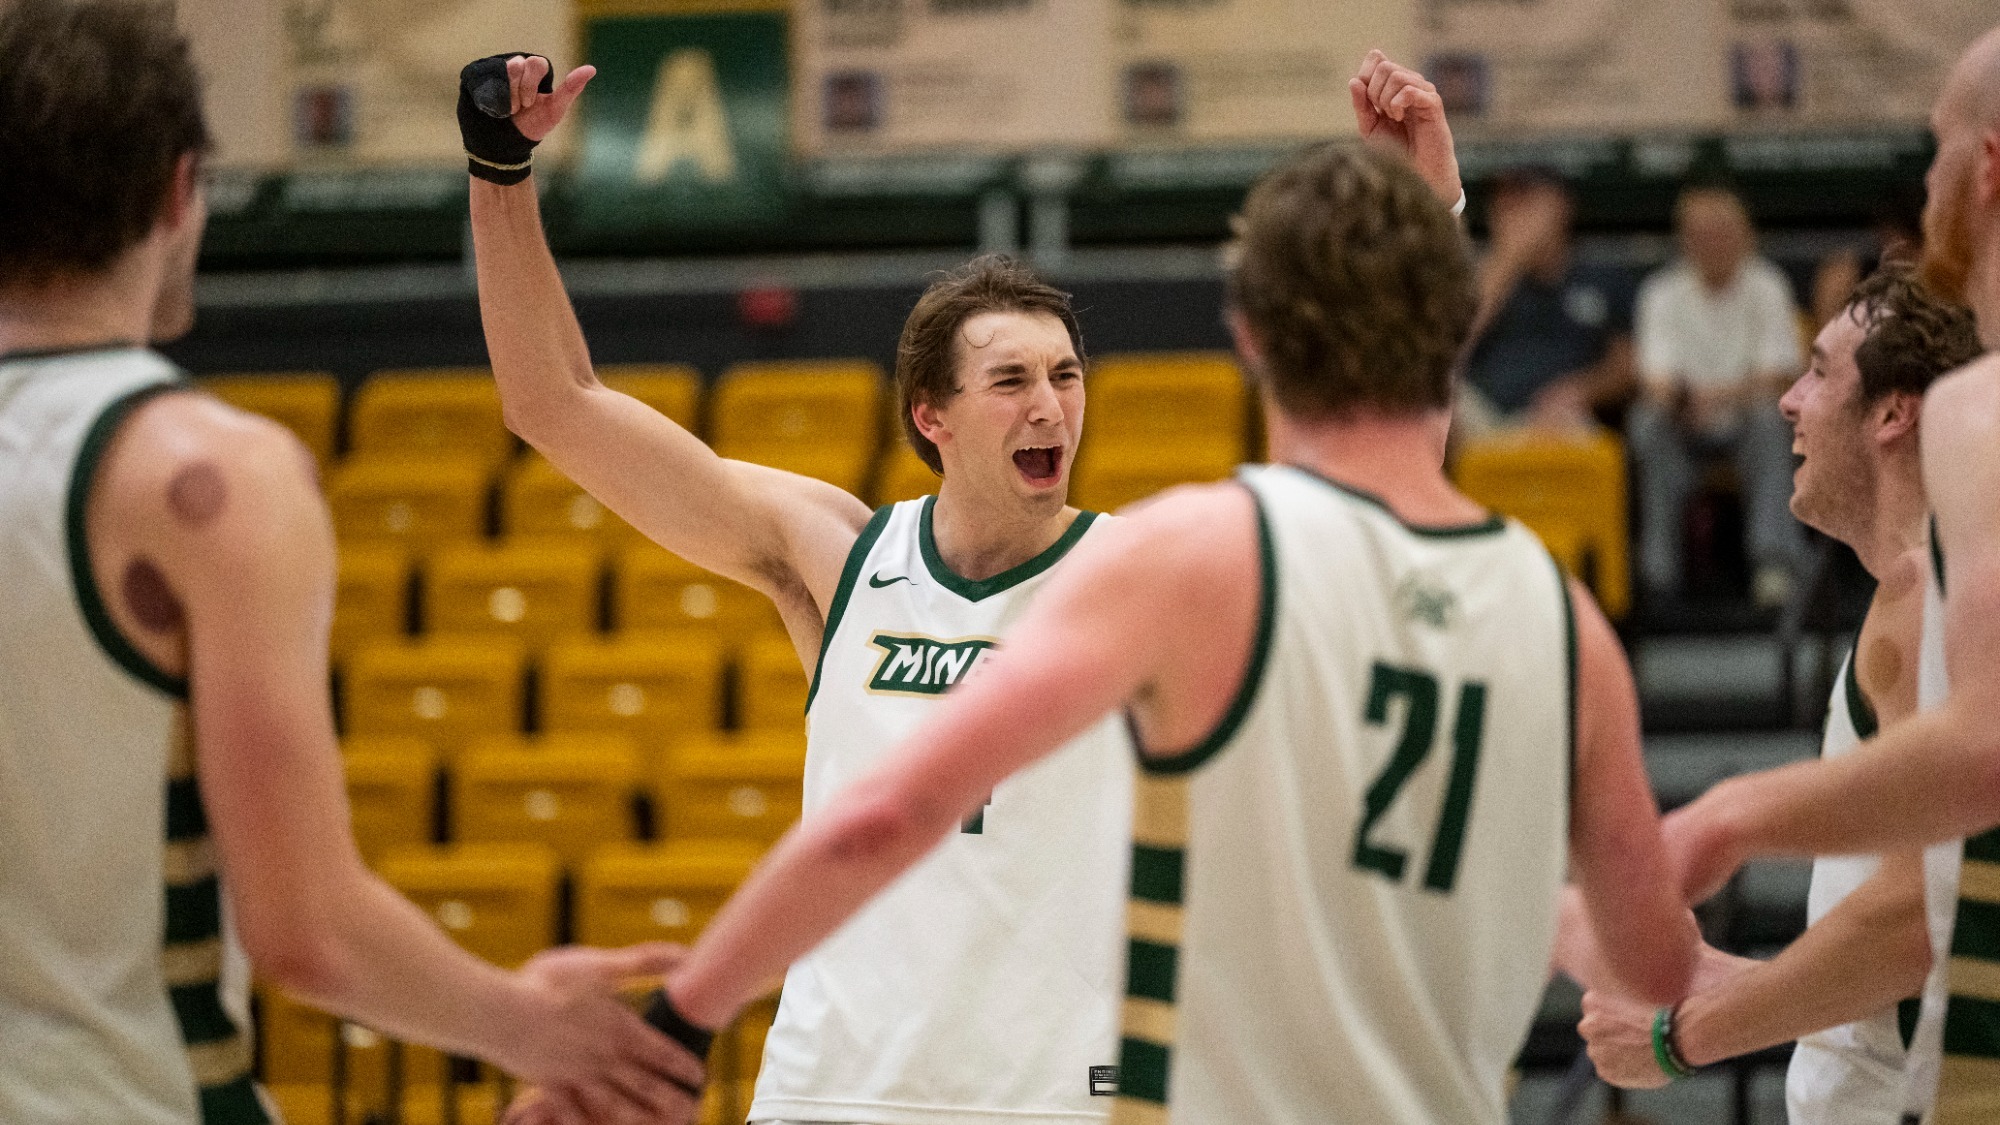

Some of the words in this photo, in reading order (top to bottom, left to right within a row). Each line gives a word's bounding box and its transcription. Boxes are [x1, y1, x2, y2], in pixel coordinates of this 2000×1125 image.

[638, 50, 736, 181] A
[880, 642, 996, 686] MINE
[1355, 660, 1487, 892] 21
